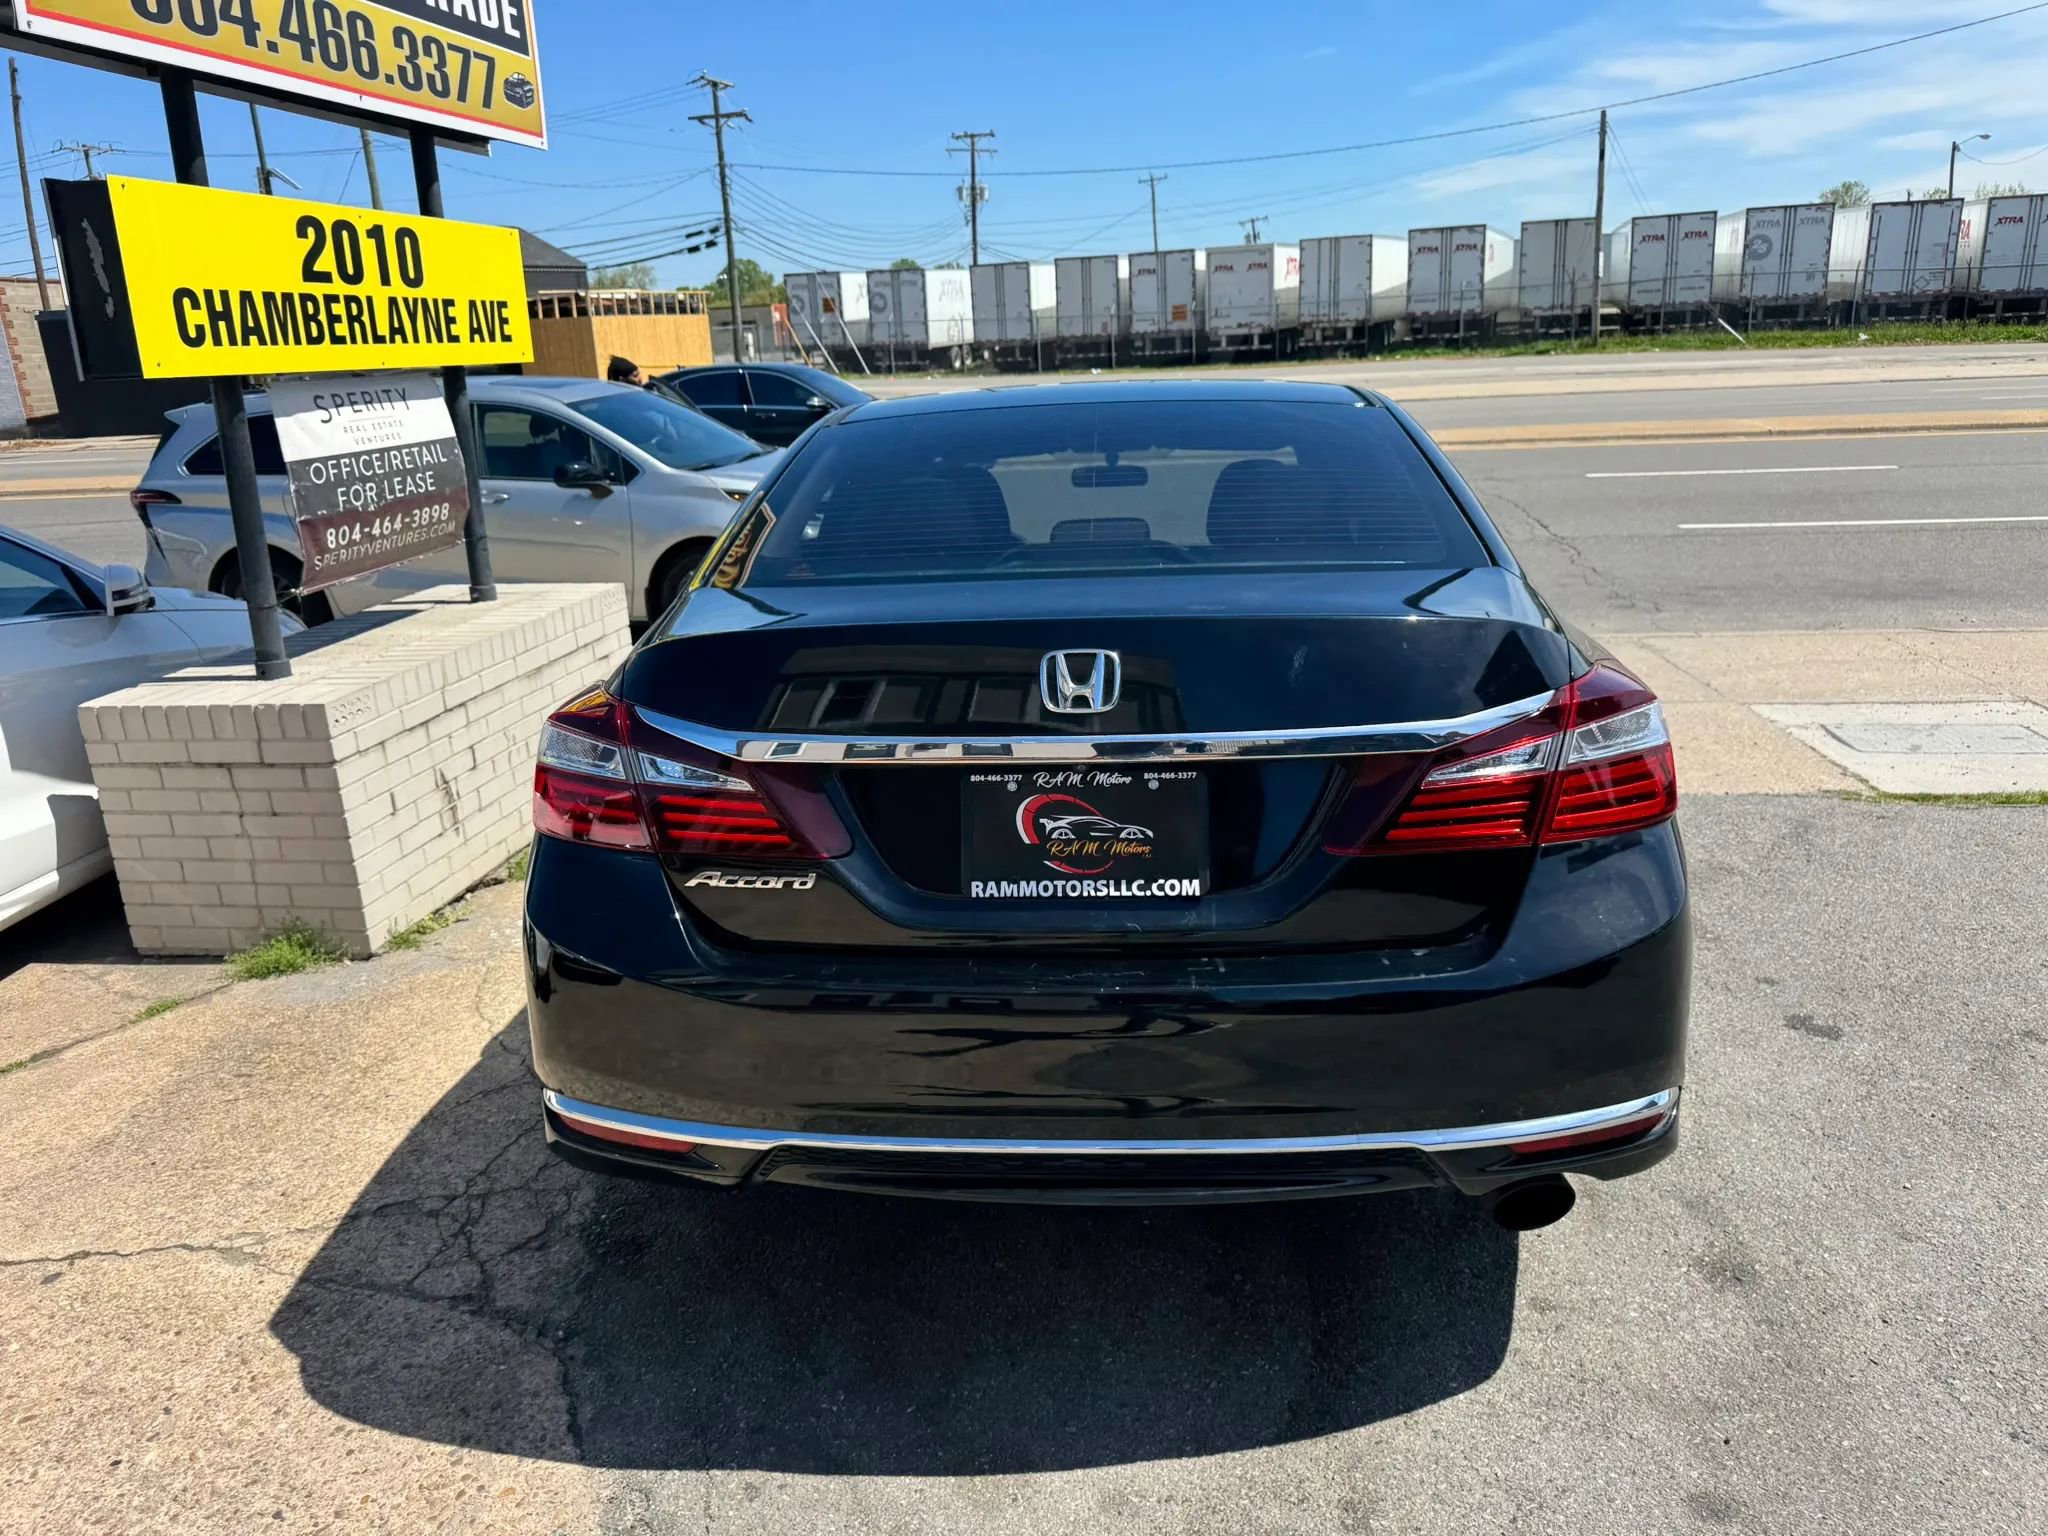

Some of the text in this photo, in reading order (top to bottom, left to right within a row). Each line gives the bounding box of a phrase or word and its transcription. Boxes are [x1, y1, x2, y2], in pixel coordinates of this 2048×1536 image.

[425, 0, 521, 39] DE
[1994, 216, 2024, 227] XTRA
[1639, 234, 1665, 244] XTRA
[1681, 230, 1708, 241] XTRA
[295, 214, 425, 289] 2010
[172, 286, 513, 348] CHAMBERLAYNE AVE
[313, 387, 410, 424] SPERITY
[343, 419, 404, 434] REAL ESTATE
[354, 432, 402, 446] VENTURES
[310, 443, 448, 485] OFFICE/RETAIL
[337, 471, 436, 511] FOR LEASE
[326, 502, 450, 549] 804-464-3898
[314, 521, 456, 571] SPERITYVENTURES.COM
[970, 774, 1022, 783] 804-466-3377
[1033, 771, 1132, 788] RAM Motors
[1143, 772, 1197, 780] 804-466-3377
[1046, 839, 1152, 857] RAM Motors
[684, 871, 817, 889] Accord
[970, 878, 1201, 898] RAMMOTORSLLC.COM
